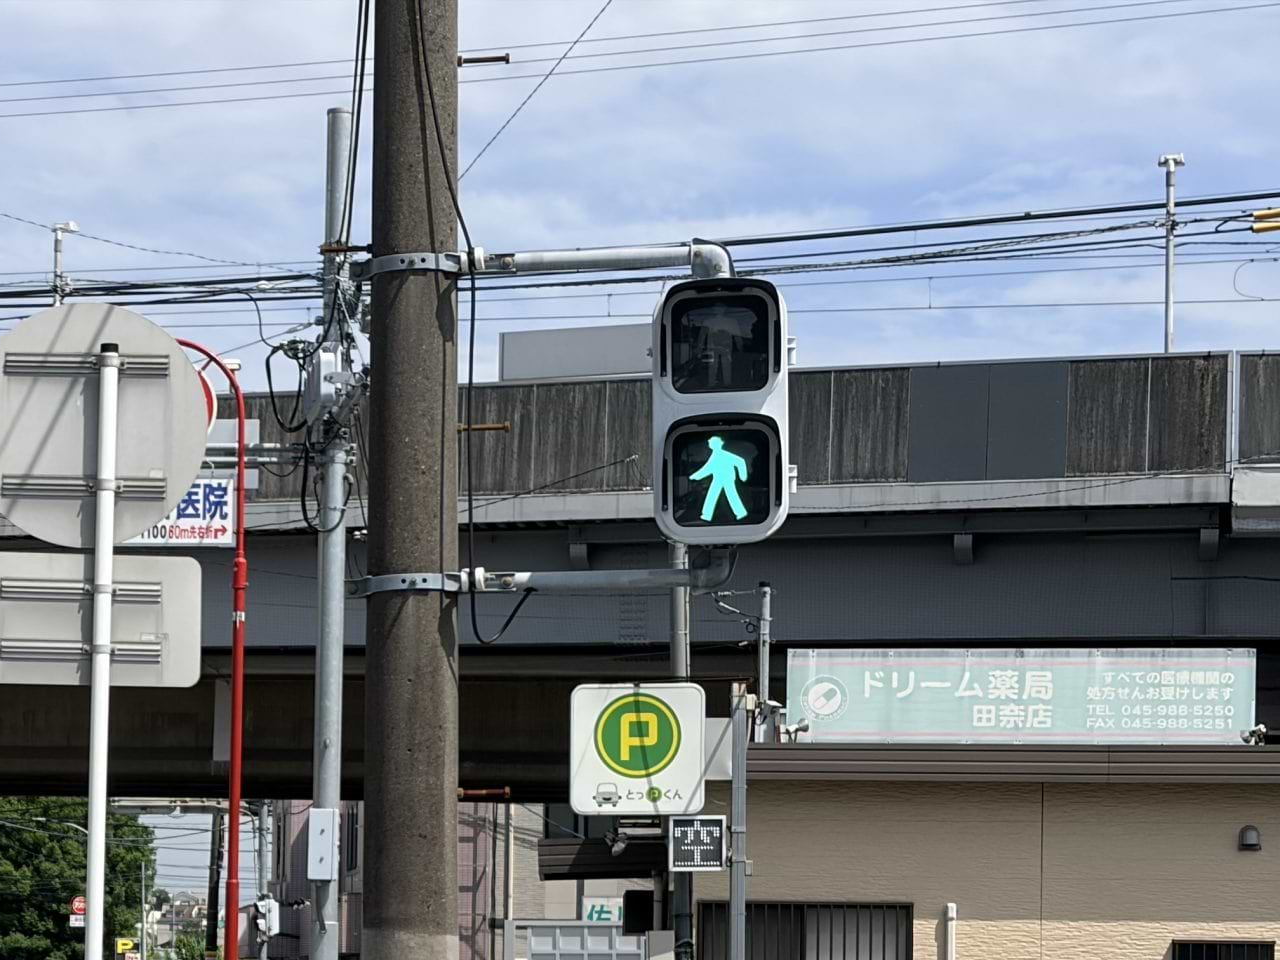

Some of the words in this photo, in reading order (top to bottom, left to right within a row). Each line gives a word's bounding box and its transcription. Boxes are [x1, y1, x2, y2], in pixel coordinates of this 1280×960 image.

[167, 483, 228, 520] 医院
[863, 669, 1054, 700] ドリーム薬局
[1086, 686, 1234, 700] 処方せんお受けします
[972, 703, 1053, 728] 田奈店
[1086, 704, 1115, 716] TEL
[1086, 718, 1115, 729] FAX
[620, 712, 658, 761] P
[673, 820, 720, 865] 空
